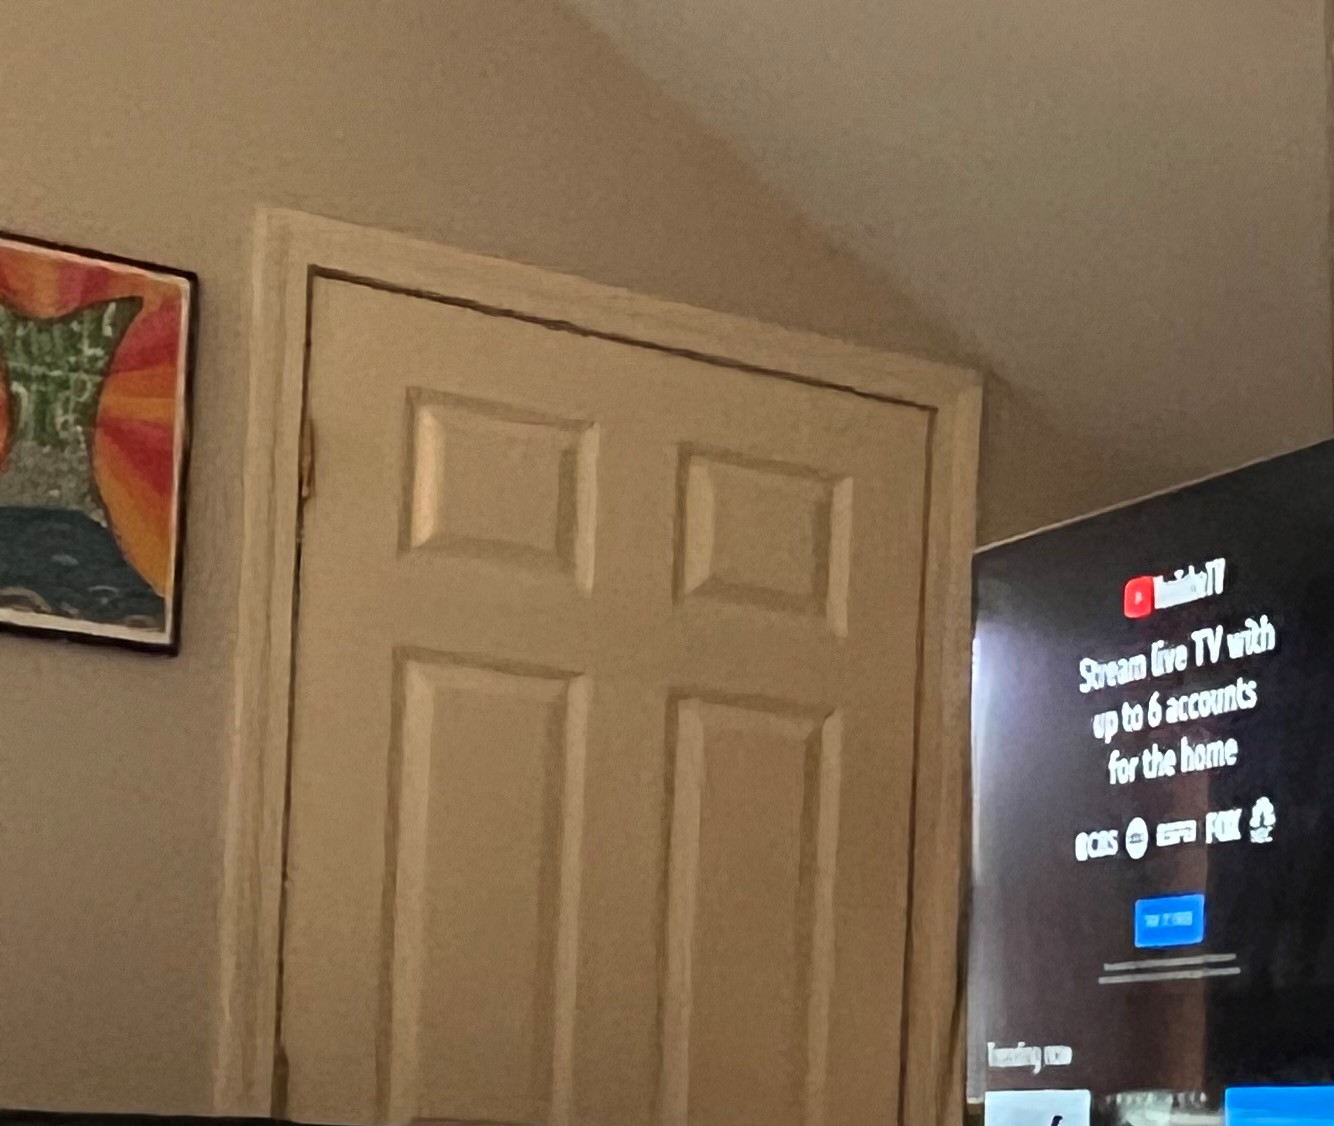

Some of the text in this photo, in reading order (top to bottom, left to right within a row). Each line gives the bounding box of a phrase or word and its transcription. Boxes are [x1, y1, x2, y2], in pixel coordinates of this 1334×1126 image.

[1079, 614, 1276, 694] Stream live TV with
[1092, 677, 1258, 744] up to 6 accounts
[1108, 736, 1238, 785] for the home
[1205, 808, 1242, 844] FOX
